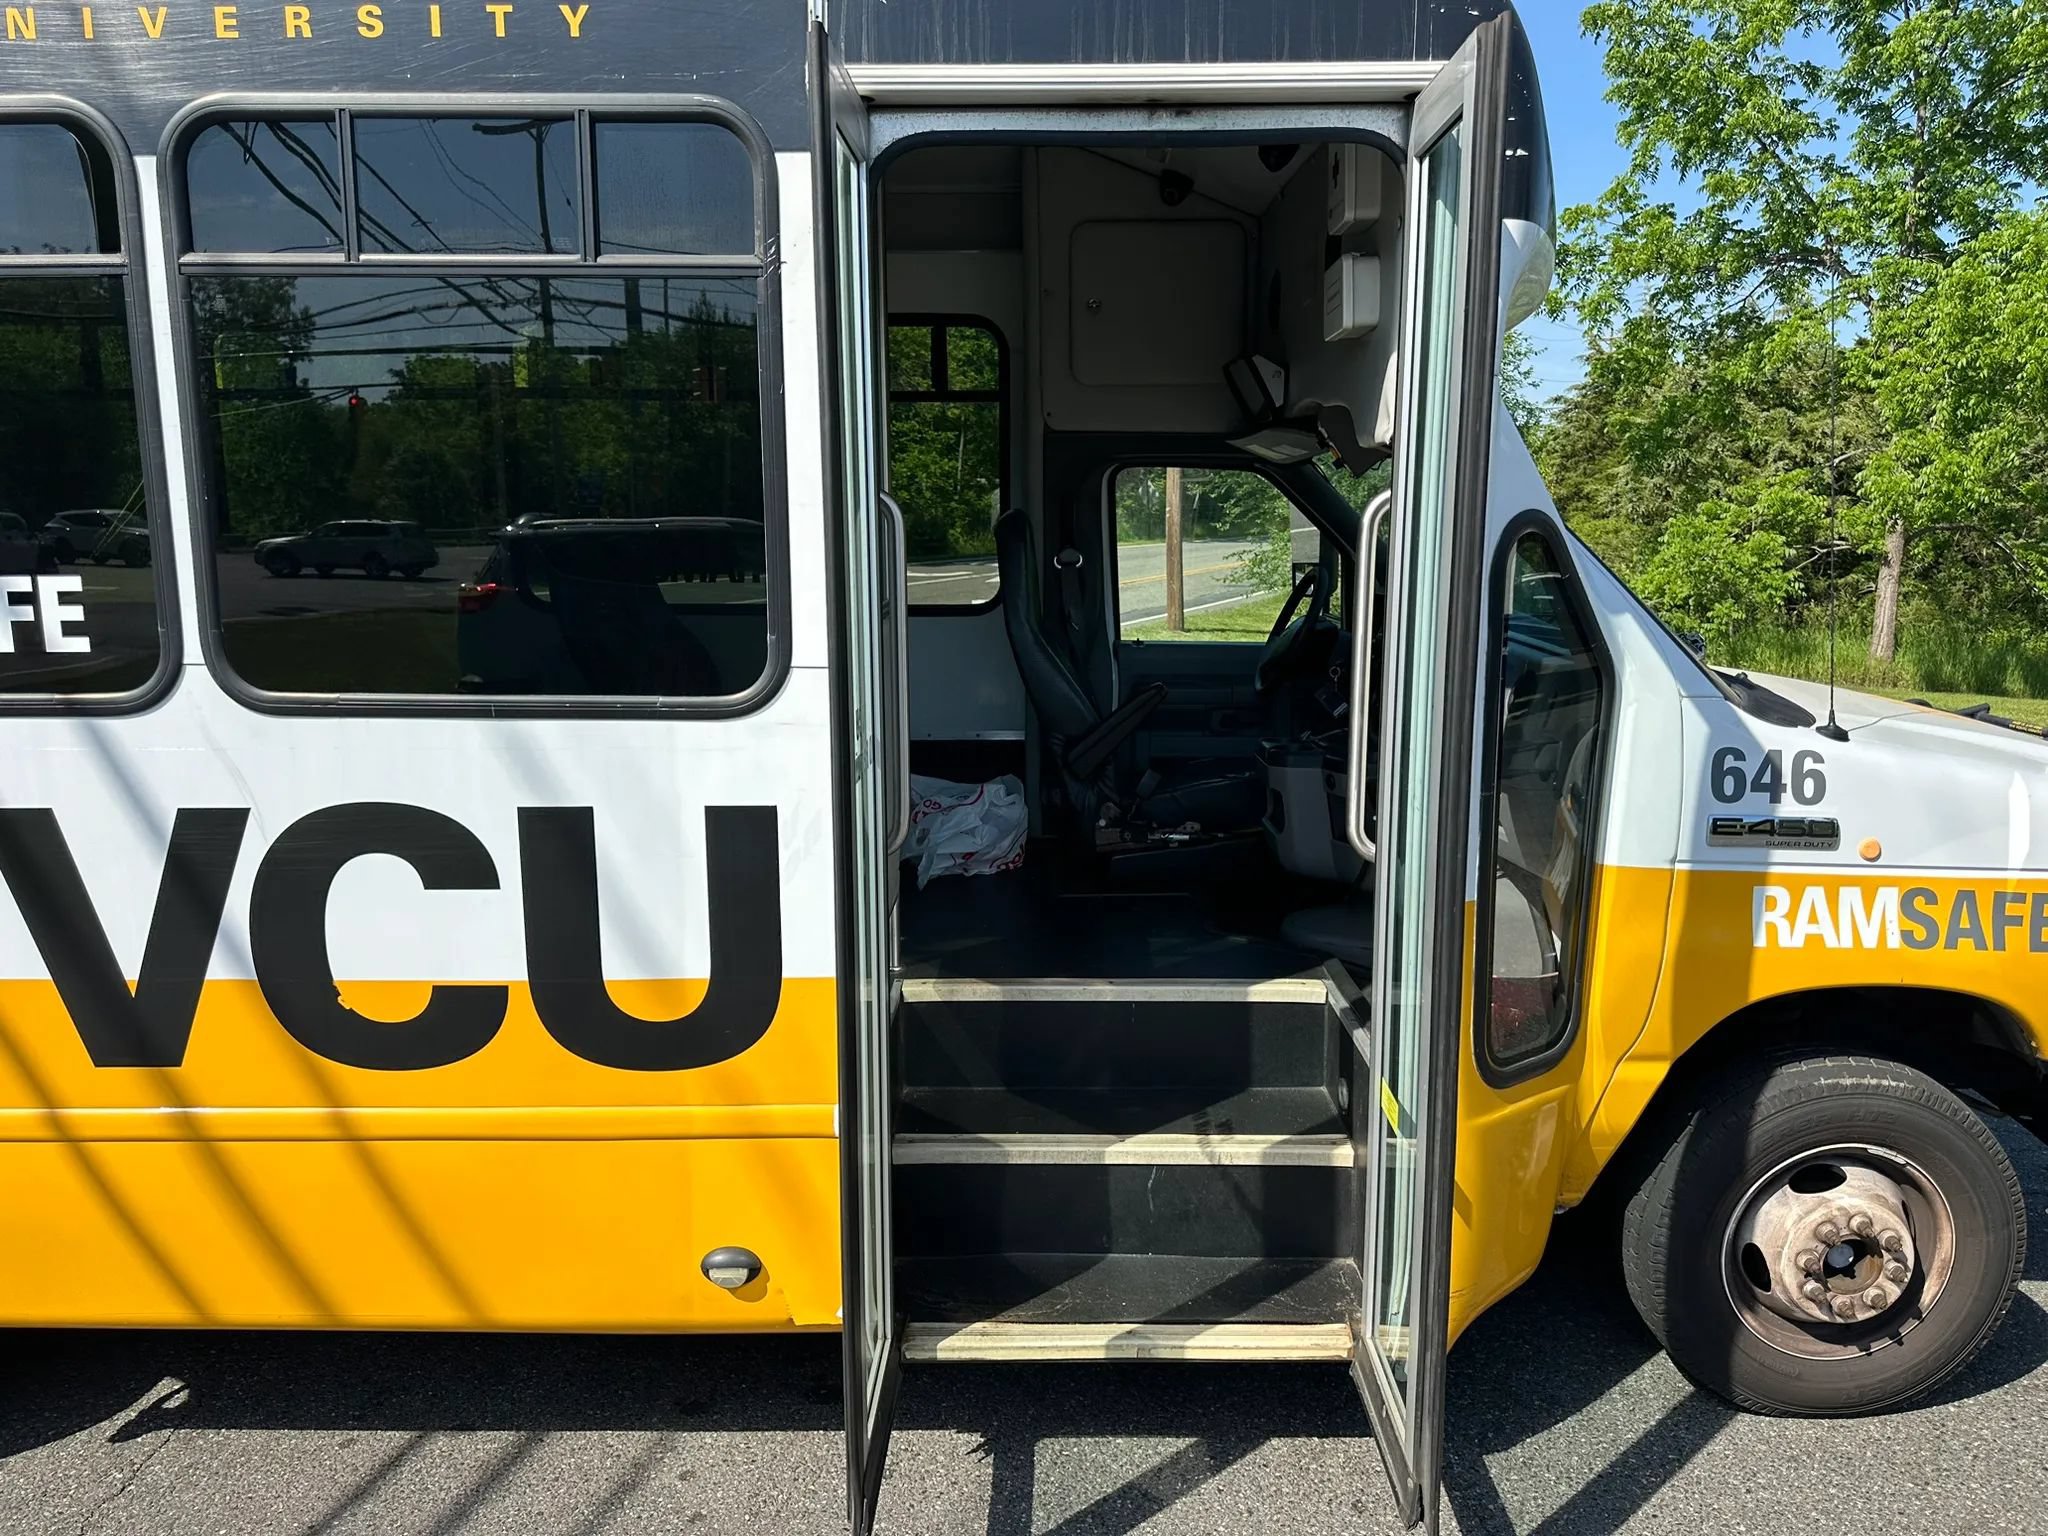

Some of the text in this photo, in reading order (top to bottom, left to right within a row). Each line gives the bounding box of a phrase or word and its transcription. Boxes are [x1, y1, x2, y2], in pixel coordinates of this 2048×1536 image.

[6, 3, 590, 40] NIVERSITY
[0, 574, 92, 653] FE
[1710, 746, 1828, 806] 646
[1711, 817, 1839, 838] E-450
[1765, 839, 1835, 849] SUPER DUTY
[0, 801, 783, 1072] VCU
